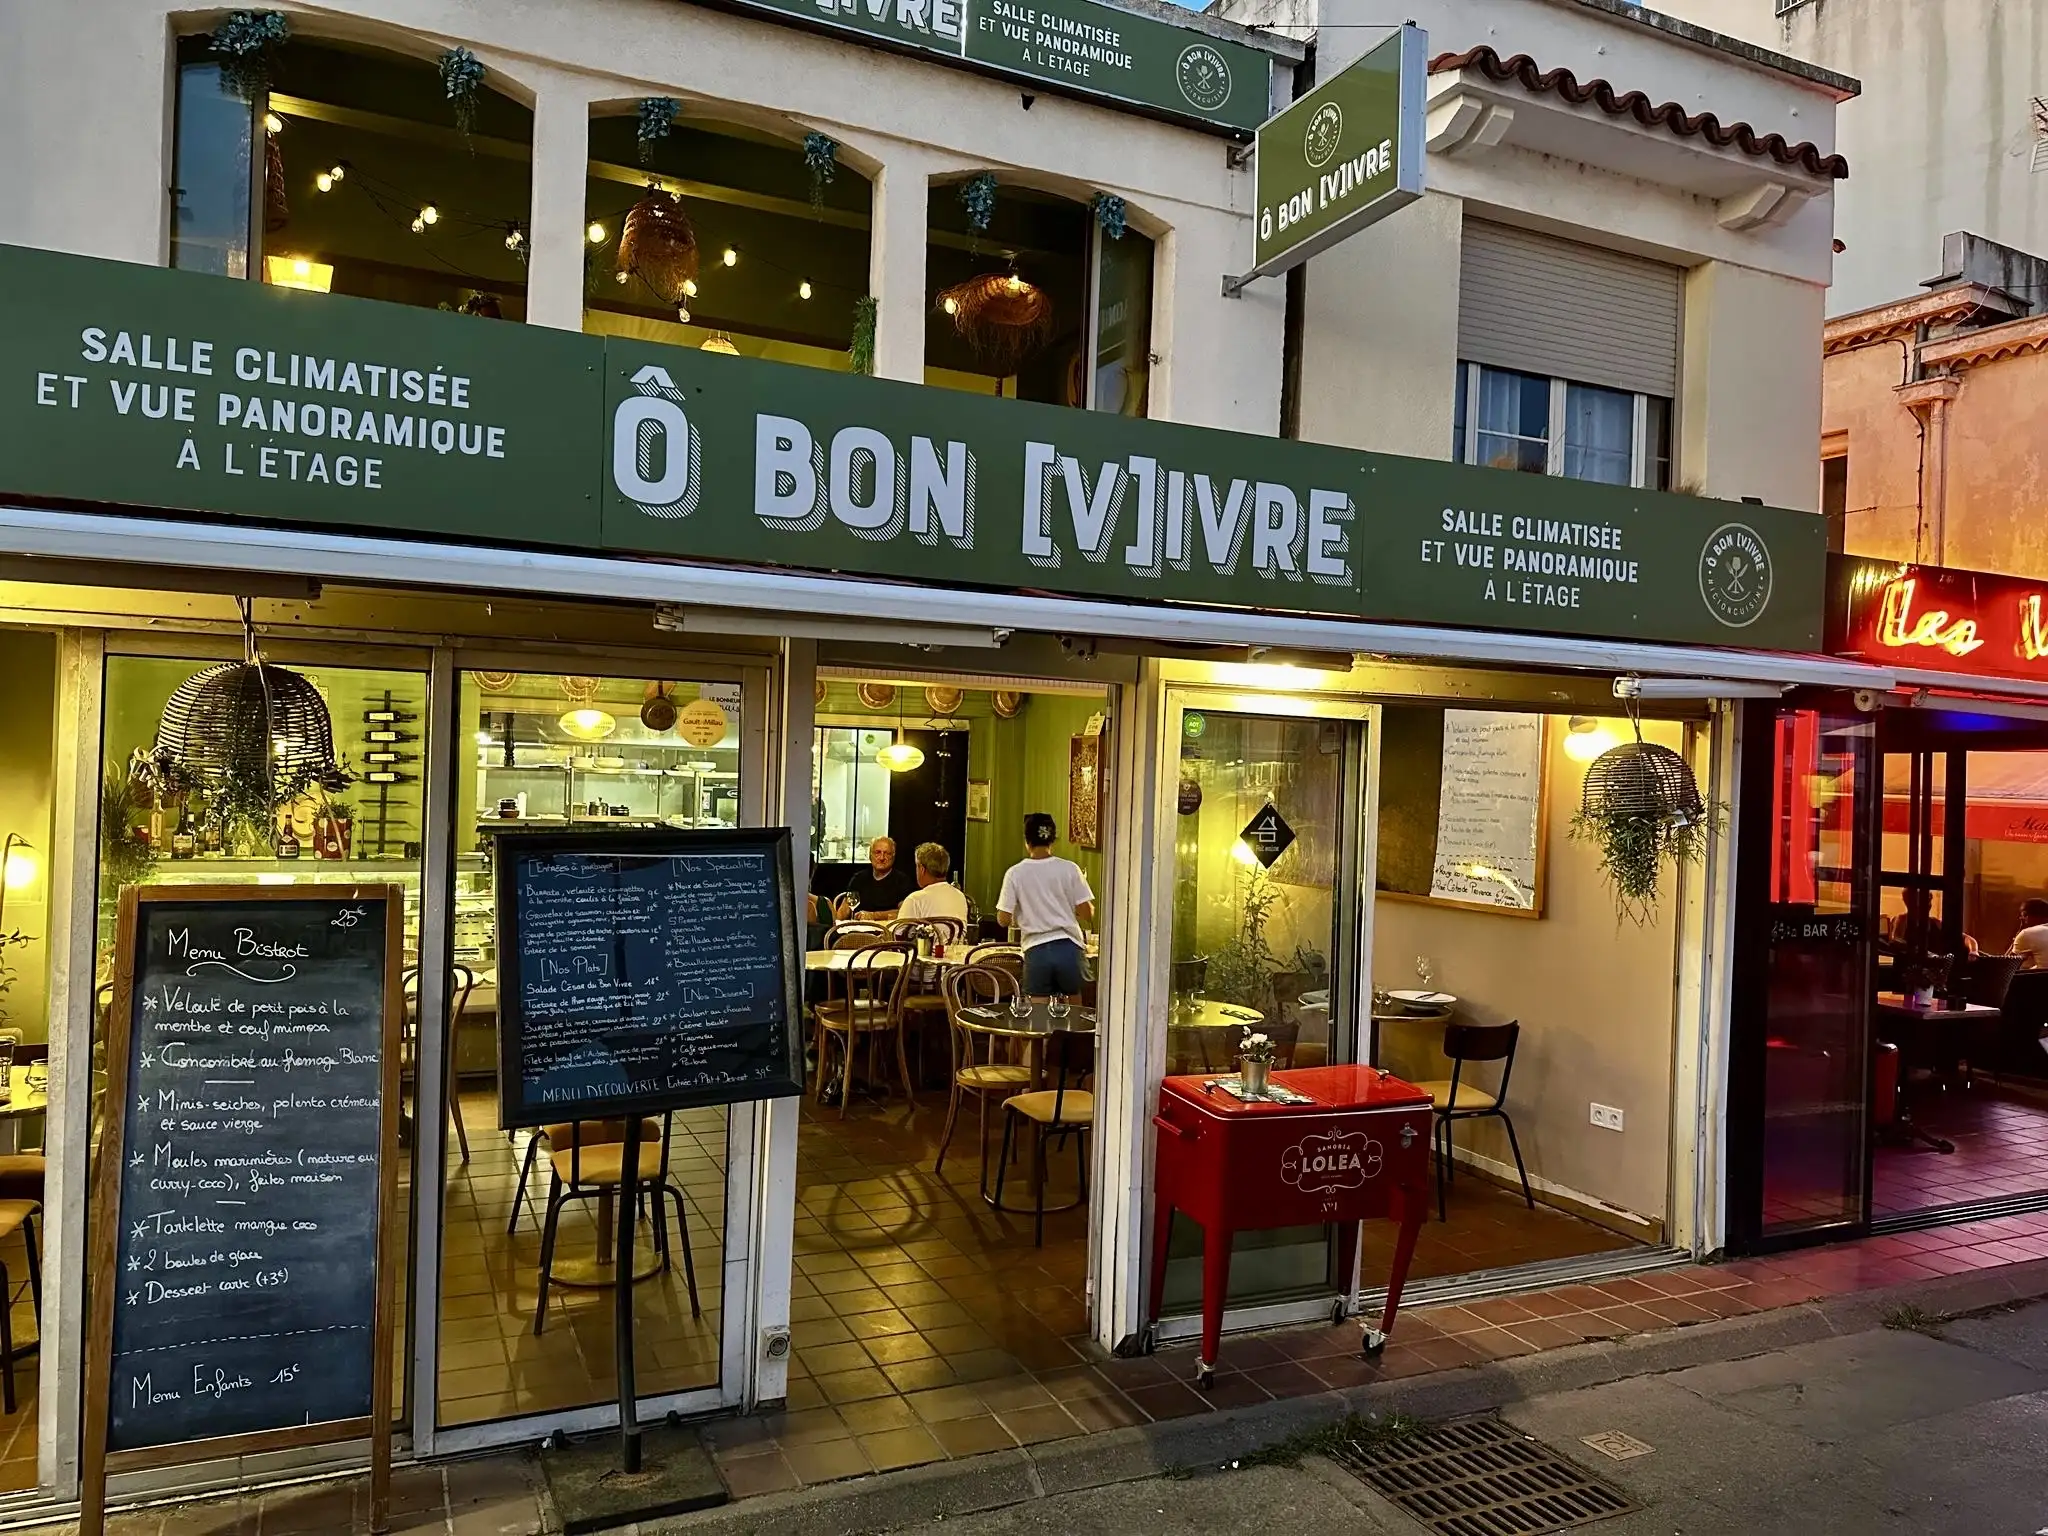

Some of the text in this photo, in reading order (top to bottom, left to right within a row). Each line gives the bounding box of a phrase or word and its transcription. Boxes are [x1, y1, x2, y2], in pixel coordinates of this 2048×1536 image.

[993, 1, 1035, 25] SALLE
[1041, 13, 1120, 48] CLIMATISÉE
[979, 16, 996, 32] ET
[1002, 21, 1030, 42] VUE
[1036, 32, 1133, 70] PANORAMIQUE
[1187, 50, 1202, 63] BON
[1261, 206, 1272, 241] Ô
[1278, 187, 1313, 232] BON
[1320, 138, 1392, 209] [V]IVRE
[81, 327, 471, 410] SALLE CLIMATISÉE
[36, 372, 505, 459] ET VUE PANORAMIQUE
[613, 364, 1354, 586] Ô BON [V]IVRE
[1442, 508, 1622, 551] SALLE CLIMATISÉE
[1421, 540, 1639, 584] ET VUE PANORAMIQUE
[1713, 534, 1734, 556] BON
[1737, 532, 1765, 572] [V]IVRE
[168, 927, 309, 960] Menu Bistrot
[1803, 924, 1828, 937] BAR
[163, 984, 349, 1022] Velouté de petit pois à la
[155, 1019, 212, 1033] menthe
[218, 1019, 233, 1034] et
[273, 1020, 331, 1035] mimosa
[160, 1042, 379, 1073] Concombre au fromage Blanc
[272, 1094, 327, 1119] polenta
[160, 1117, 263, 1135] et sauce vierge
[154, 1140, 208, 1168] Moules
[214, 1149, 293, 1167] marinières
[358, 1154, 375, 1164] ou
[1302, 1153, 1361, 1173] LOLEA
[248, 1167, 285, 1192] faites
[290, 1172, 342, 1184] maison
[235, 1219, 287, 1237] mangue
[292, 1221, 318, 1231] coco
[143, 1247, 263, 1272] 2 boules de glace
[145, 1279, 212, 1304] Dessert
[219, 1277, 250, 1292] carte
[132, 1362, 301, 1409] Menu Enfants 15€
